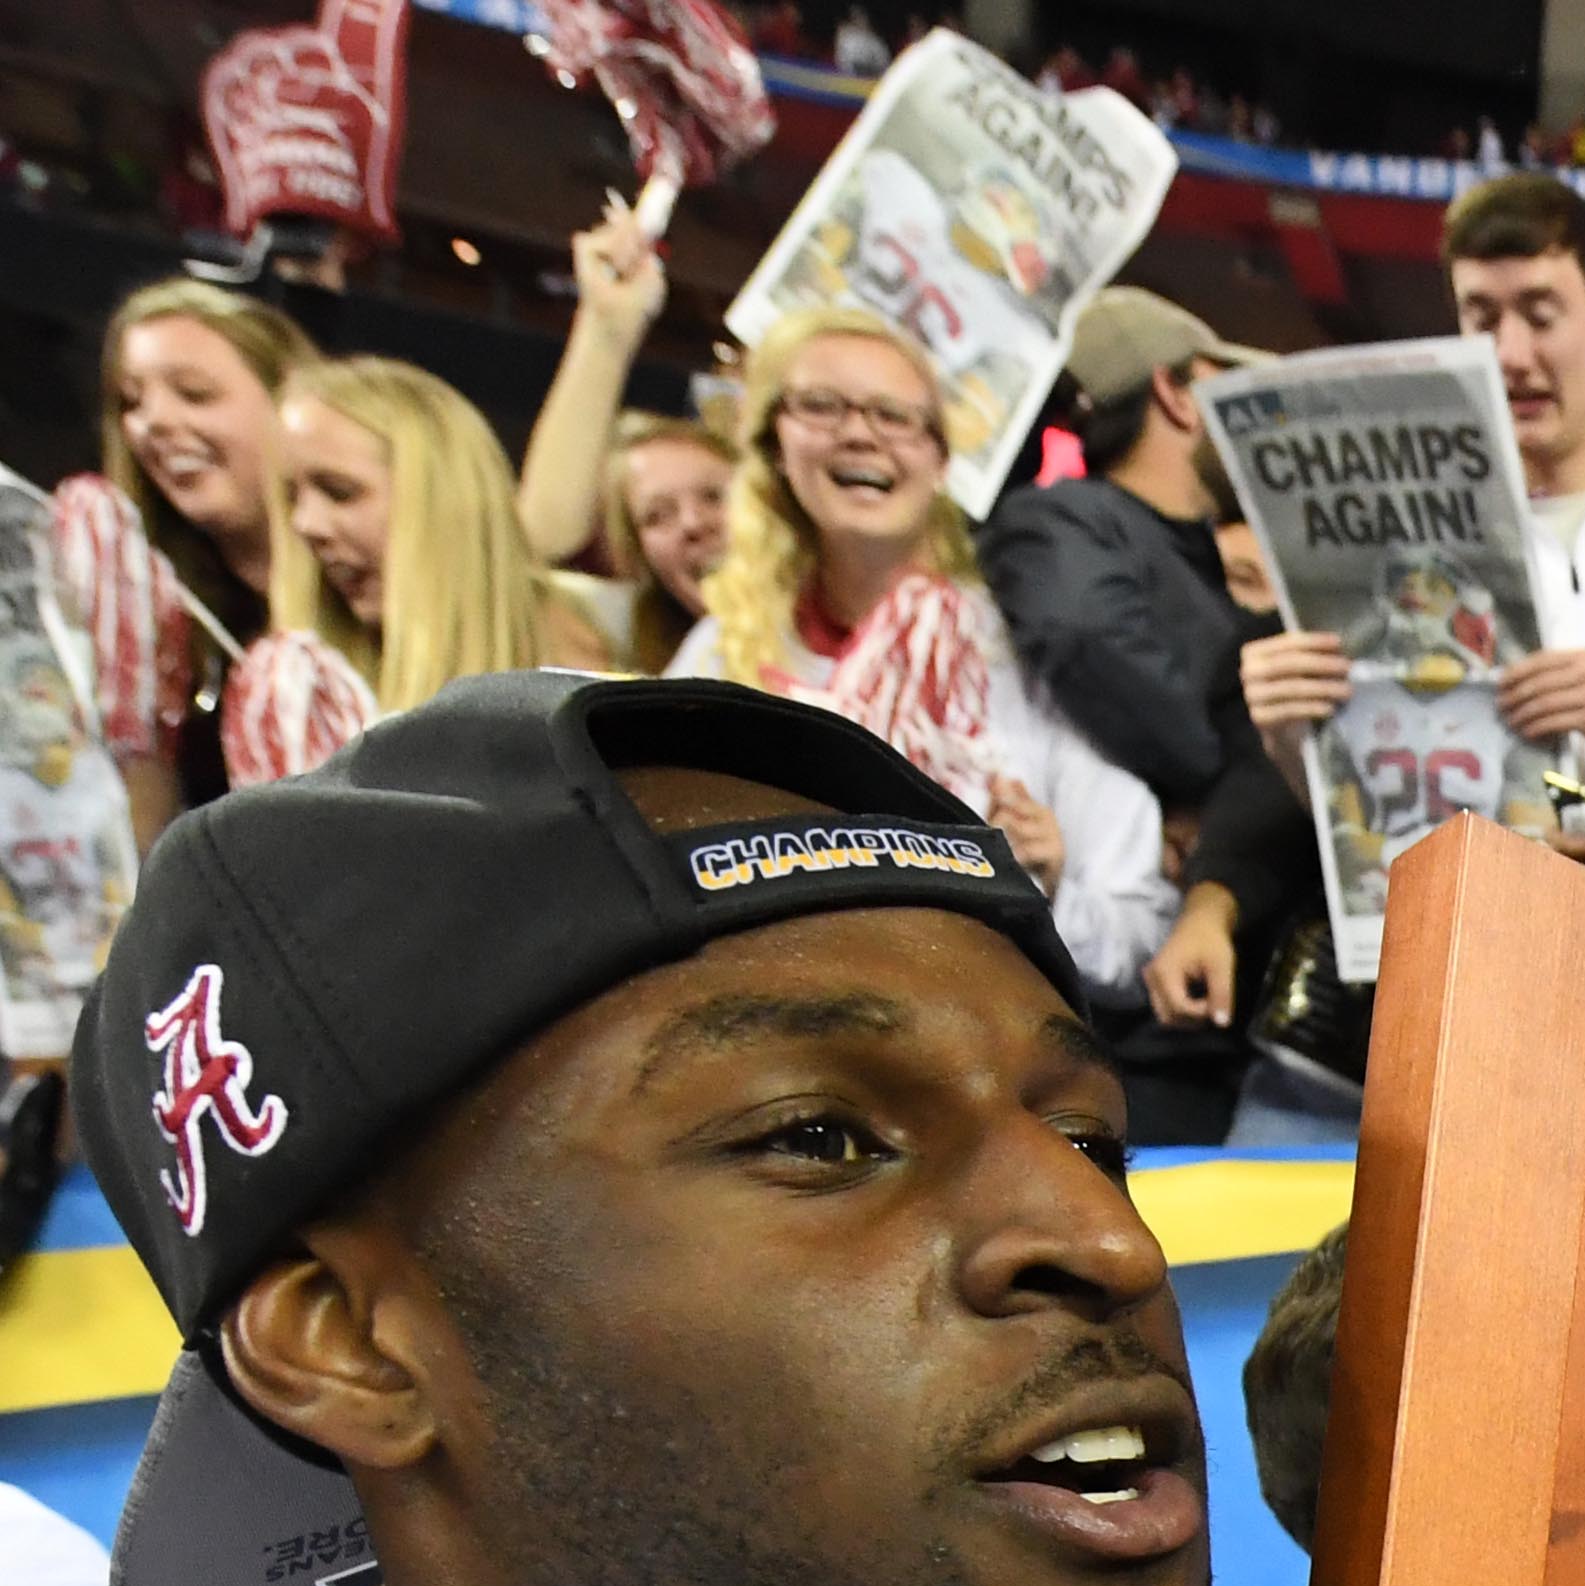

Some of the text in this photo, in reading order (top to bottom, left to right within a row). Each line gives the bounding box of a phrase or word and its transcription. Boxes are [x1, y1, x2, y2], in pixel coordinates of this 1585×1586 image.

[1252, 424, 1492, 491] CHAMPS
[1305, 489, 1485, 549] AGAIN!
[690, 828, 995, 891] CHAMPIONS
[262, 1517, 368, 1562] ORE.
[265, 1539, 374, 1582] EANS
